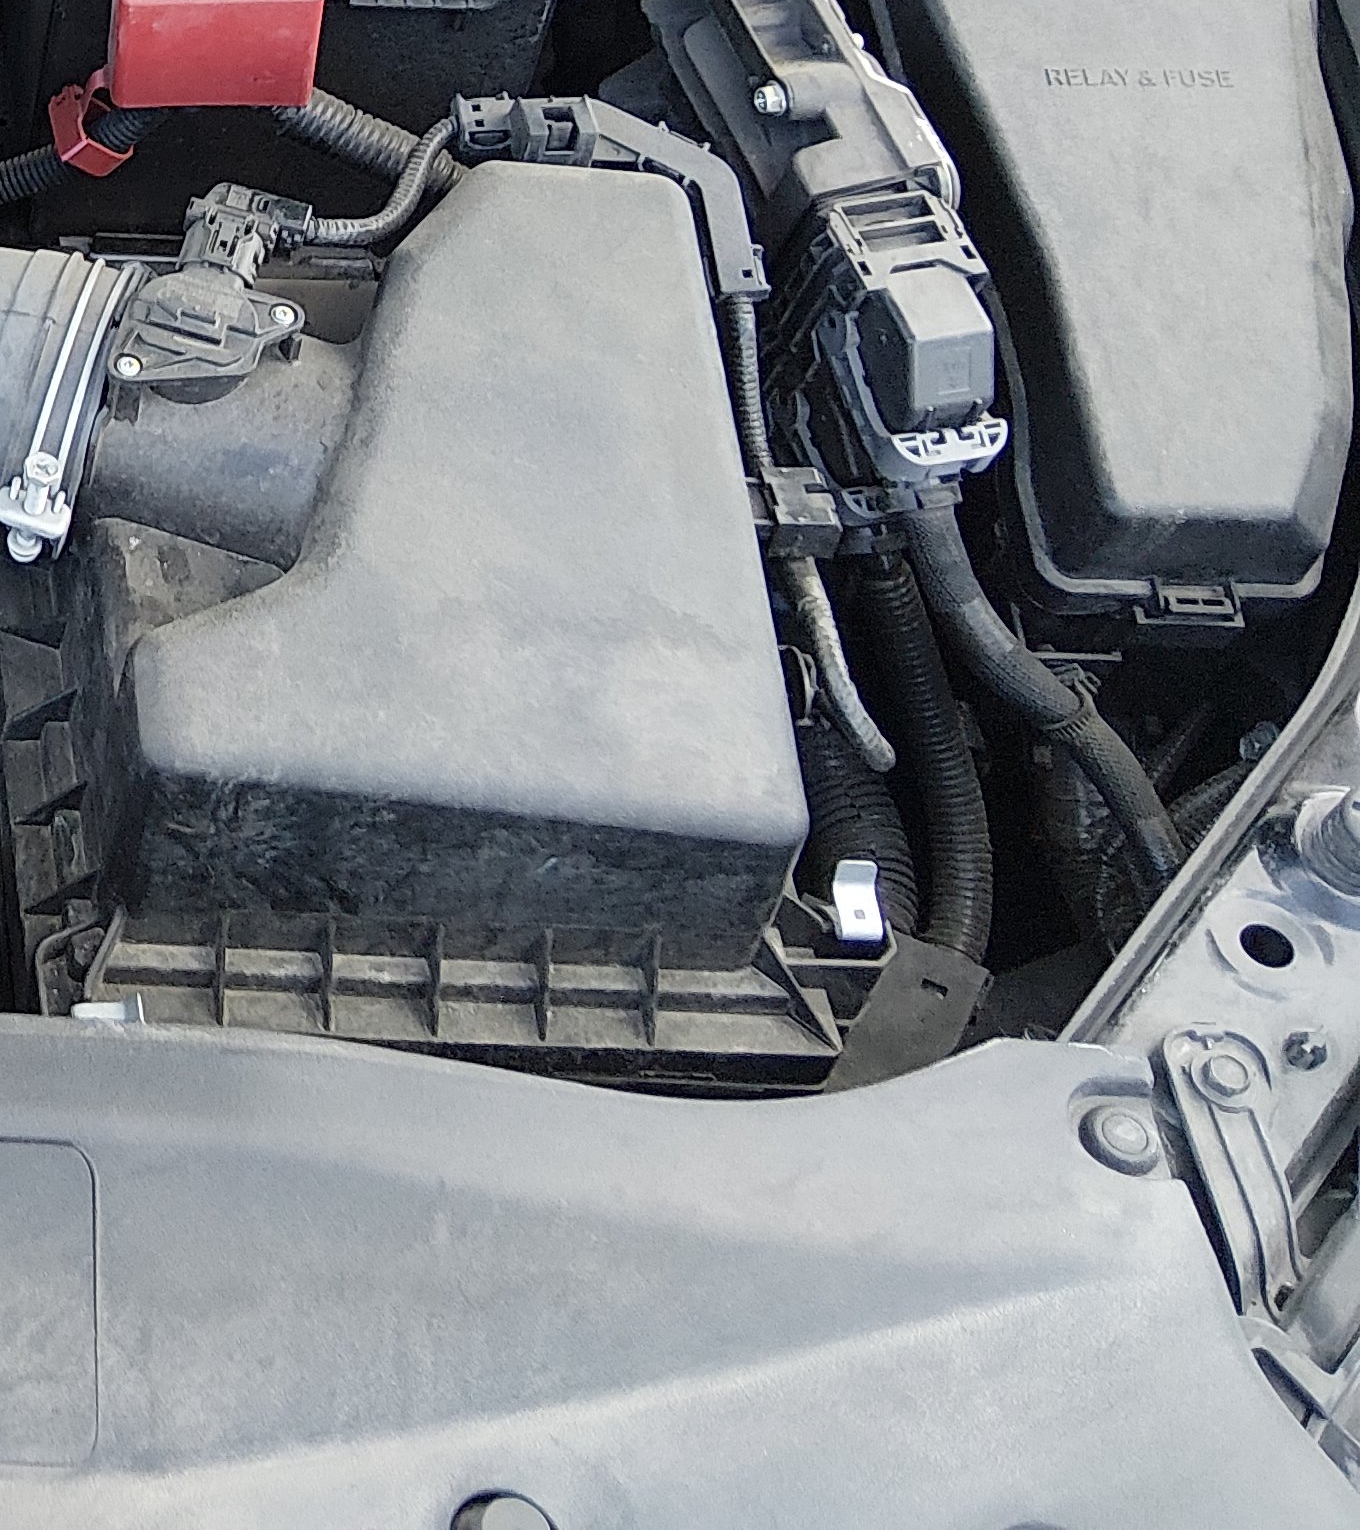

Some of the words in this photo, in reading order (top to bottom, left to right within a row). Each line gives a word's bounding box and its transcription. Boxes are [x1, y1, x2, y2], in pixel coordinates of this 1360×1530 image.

[1043, 67, 1129, 88] RELAY
[1138, 69, 1157, 88] &
[1164, 69, 1234, 89] FUSE
